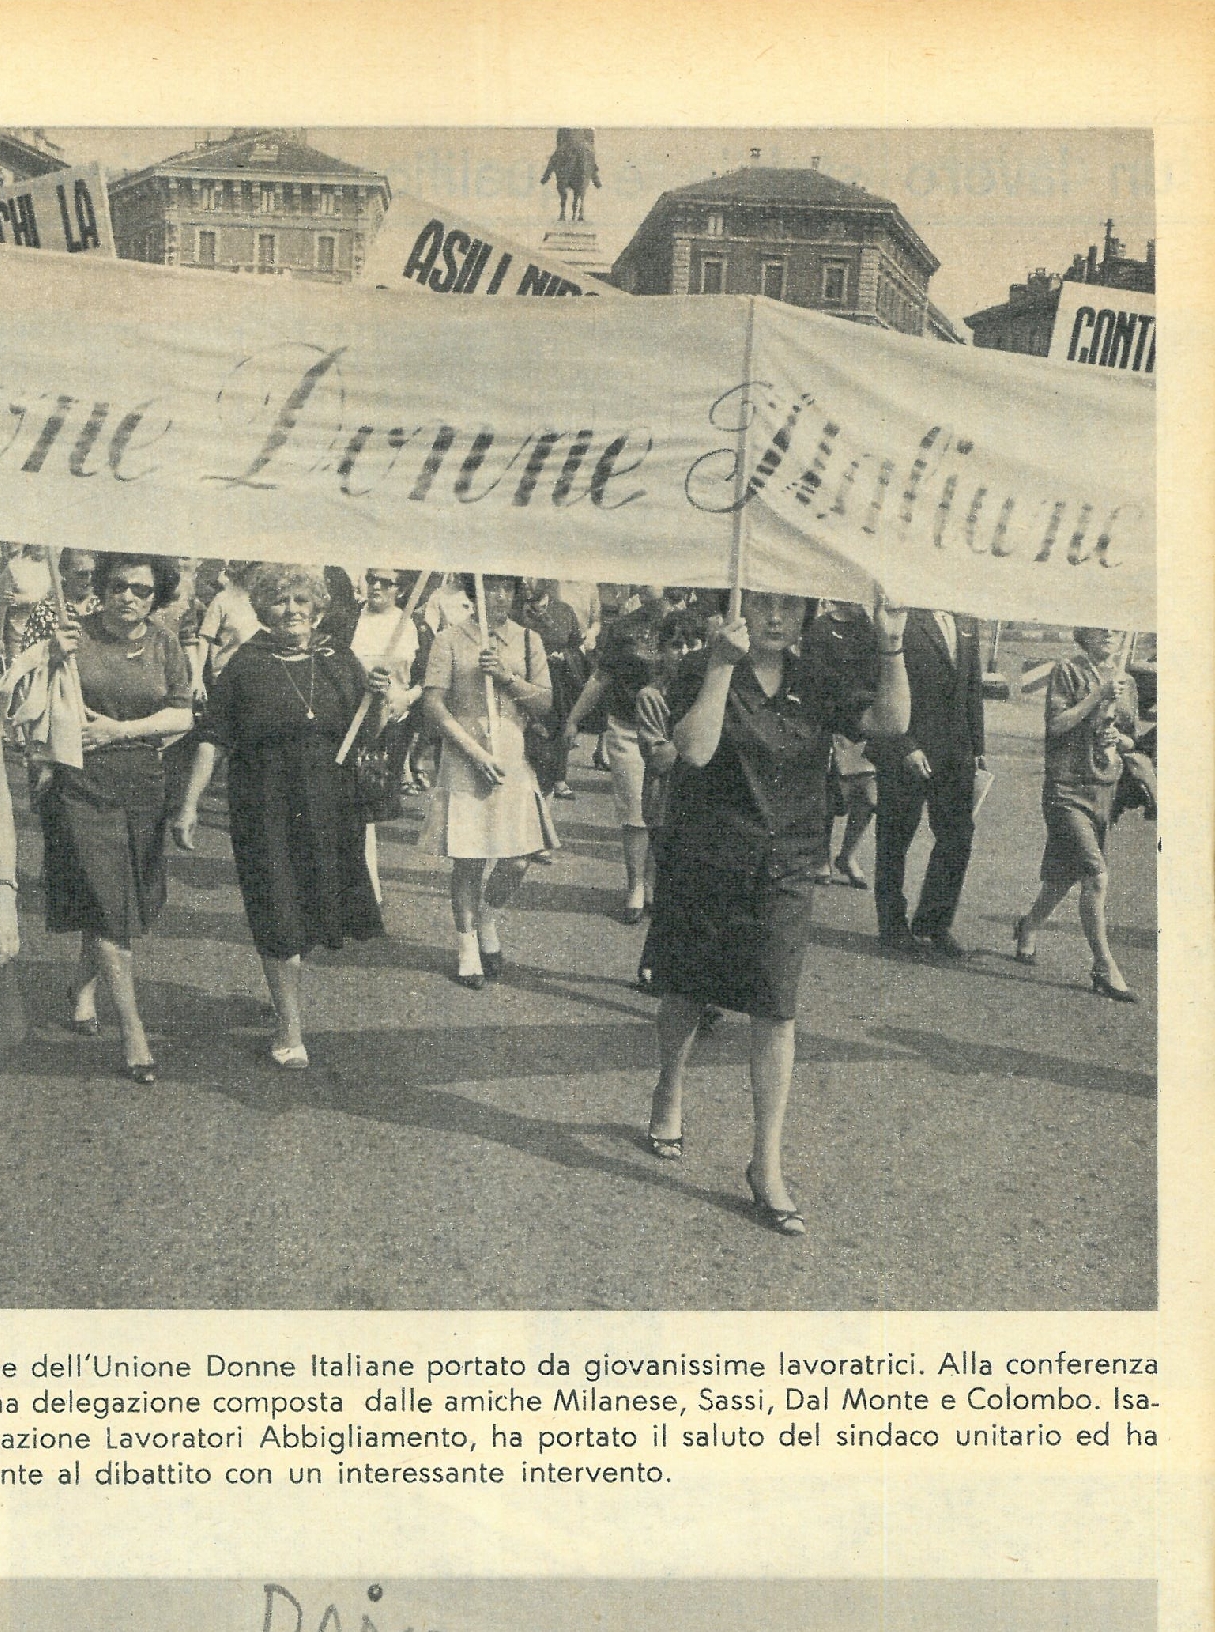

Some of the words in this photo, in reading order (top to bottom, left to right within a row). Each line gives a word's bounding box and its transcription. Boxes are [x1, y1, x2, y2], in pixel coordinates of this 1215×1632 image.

[55, 178, 103, 253] LA
[685, 381, 1149, 571] Italiane
[32, 1354, 191, 1377] dell'Unione
[208, 1355, 295, 1377] Donne
[312, 1353, 413, 1376] Italiane
[428, 1357, 525, 1383] portato
[538, 1353, 569, 1375] da
[585, 1353, 765, 1382] giovanissime
[780, 1352, 924, 1375] lavoratrici.
[938, 1351, 991, 1375] Alla
[1007, 1351, 1157, 1375] conferenza
[33, 1389, 200, 1418] delegazione
[214, 1392, 342, 1418] composta
[365, 1387, 432, 1413] dalle
[445, 1388, 541, 1411] amiche
[554, 1387, 685, 1416] Milanese,
[699, 1388, 773, 1415] Sassi,
[787, 1387, 827, 1410] Dal
[843, 1388, 928, 1410] Monte
[942, 1395, 955, 1409] e
[968, 1386, 1100, 1409] Colombo.
[1115, 1387, 1159, 1409] Isa-
